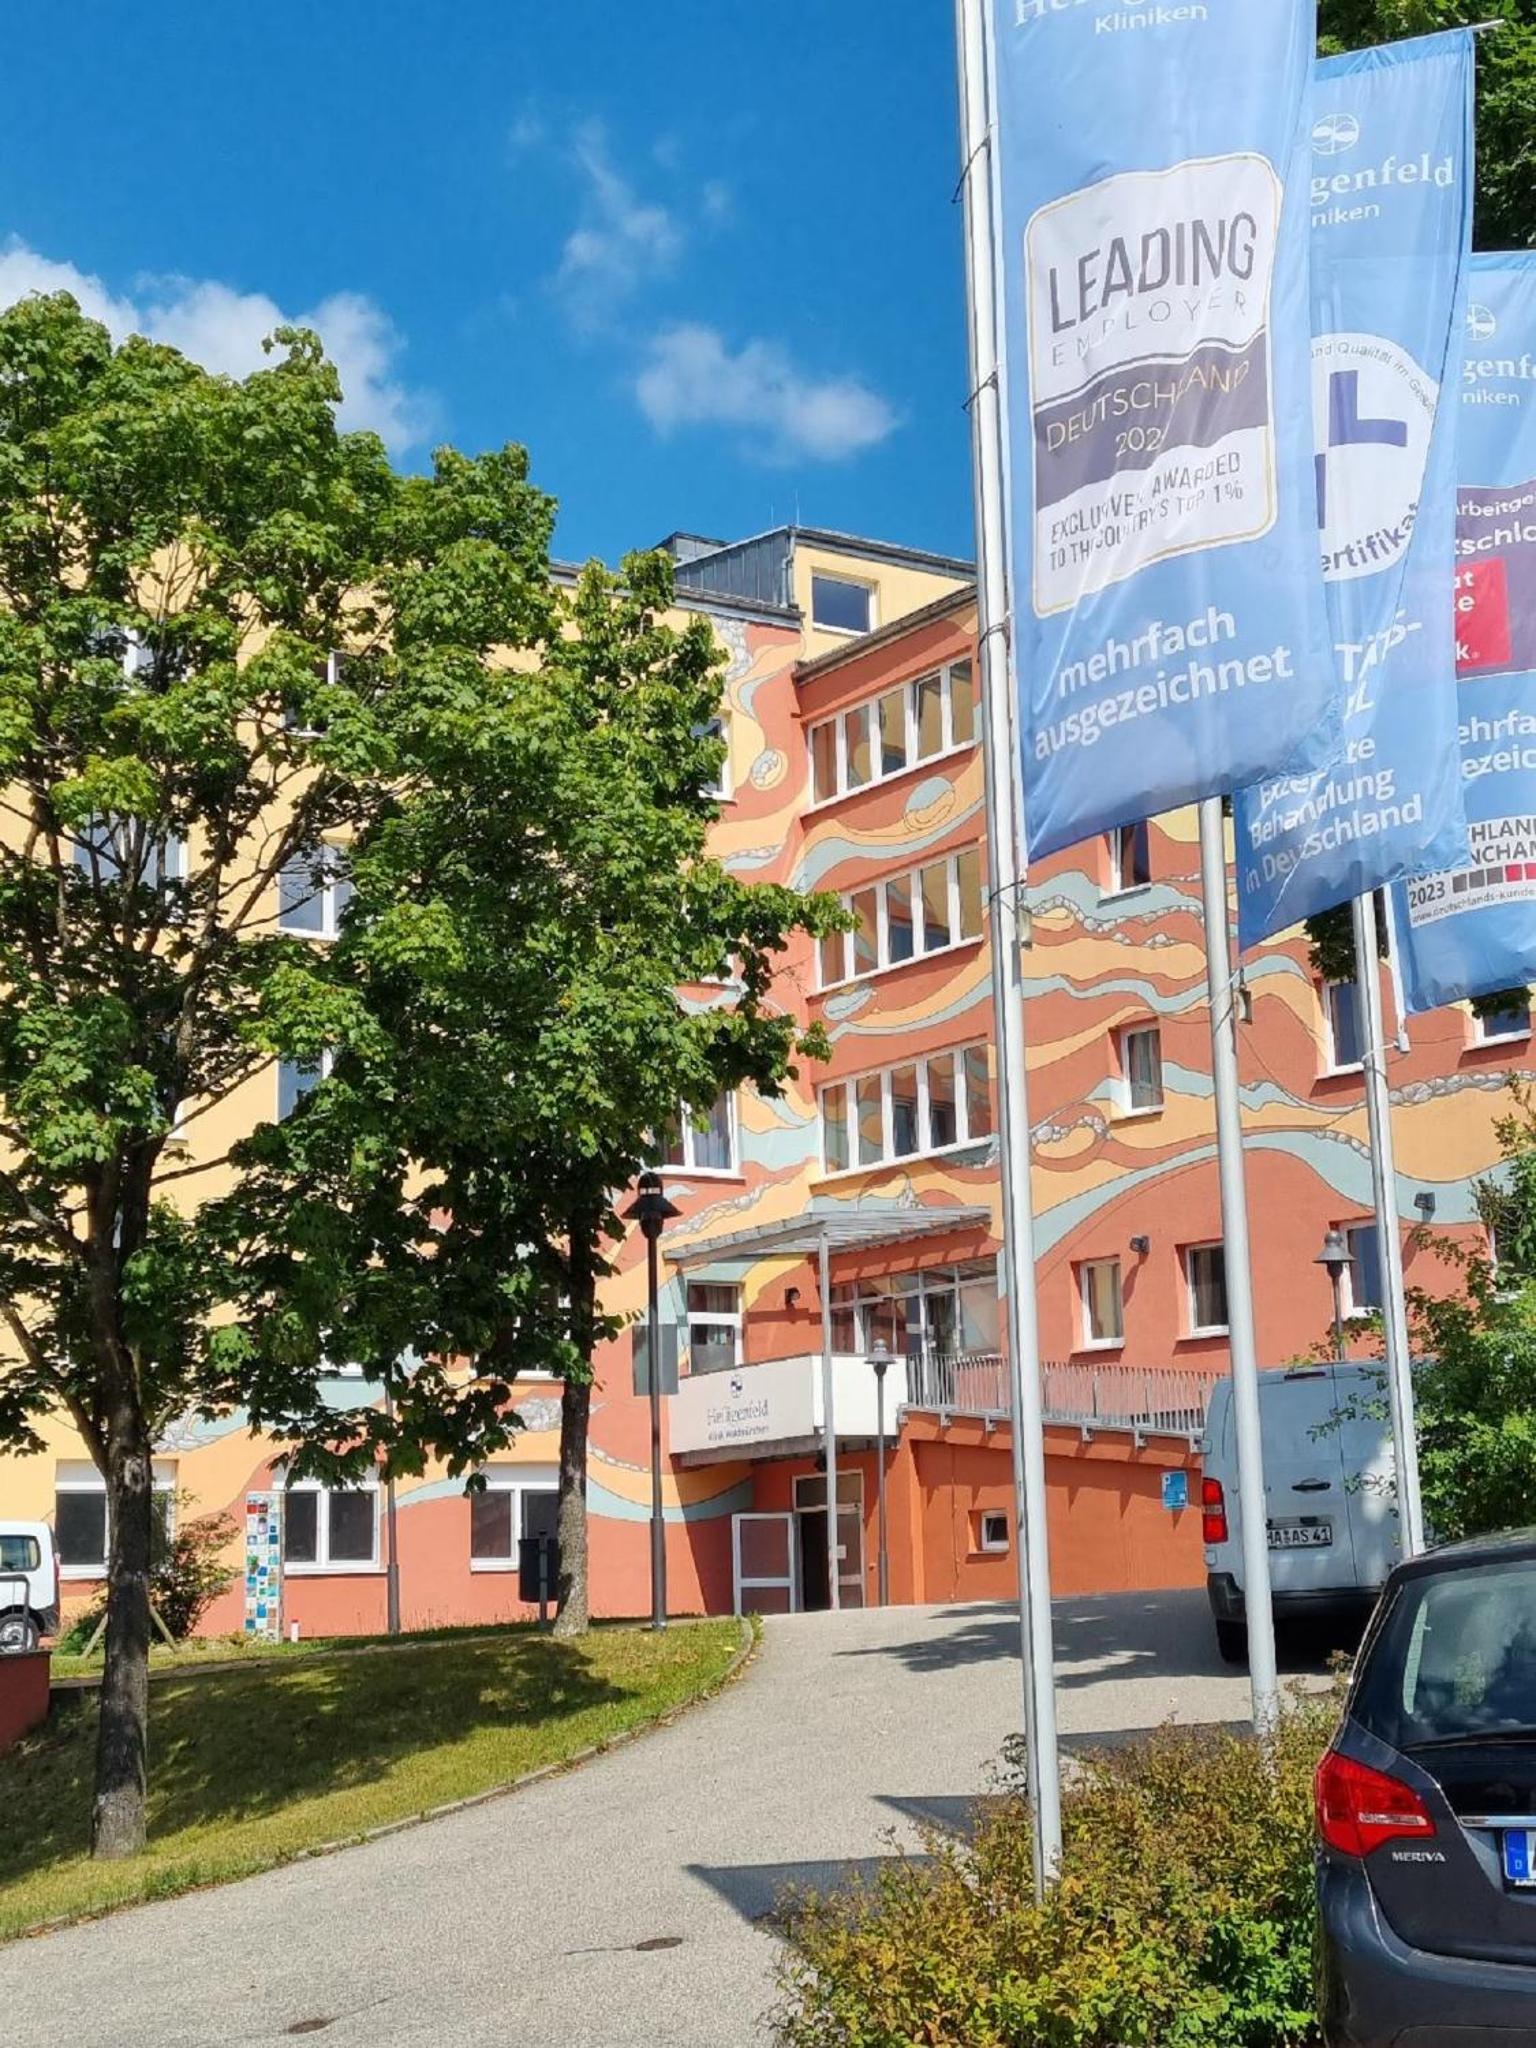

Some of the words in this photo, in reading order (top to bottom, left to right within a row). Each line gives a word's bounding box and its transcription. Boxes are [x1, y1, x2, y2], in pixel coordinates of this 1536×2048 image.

[1095, 4, 1208, 35] Kliniken
[1049, 212, 1257, 334] LEADING
[1463, 352, 1536, 385] genf
[1115, 425, 1165, 458] 202
[1070, 538, 1094, 565] TH
[1059, 606, 1236, 699] mehrfach
[1035, 645, 1295, 761] ausgezeichnet
[1409, 881, 1446, 909] 2023
[1391, 1851, 1446, 1863] MERIVA
